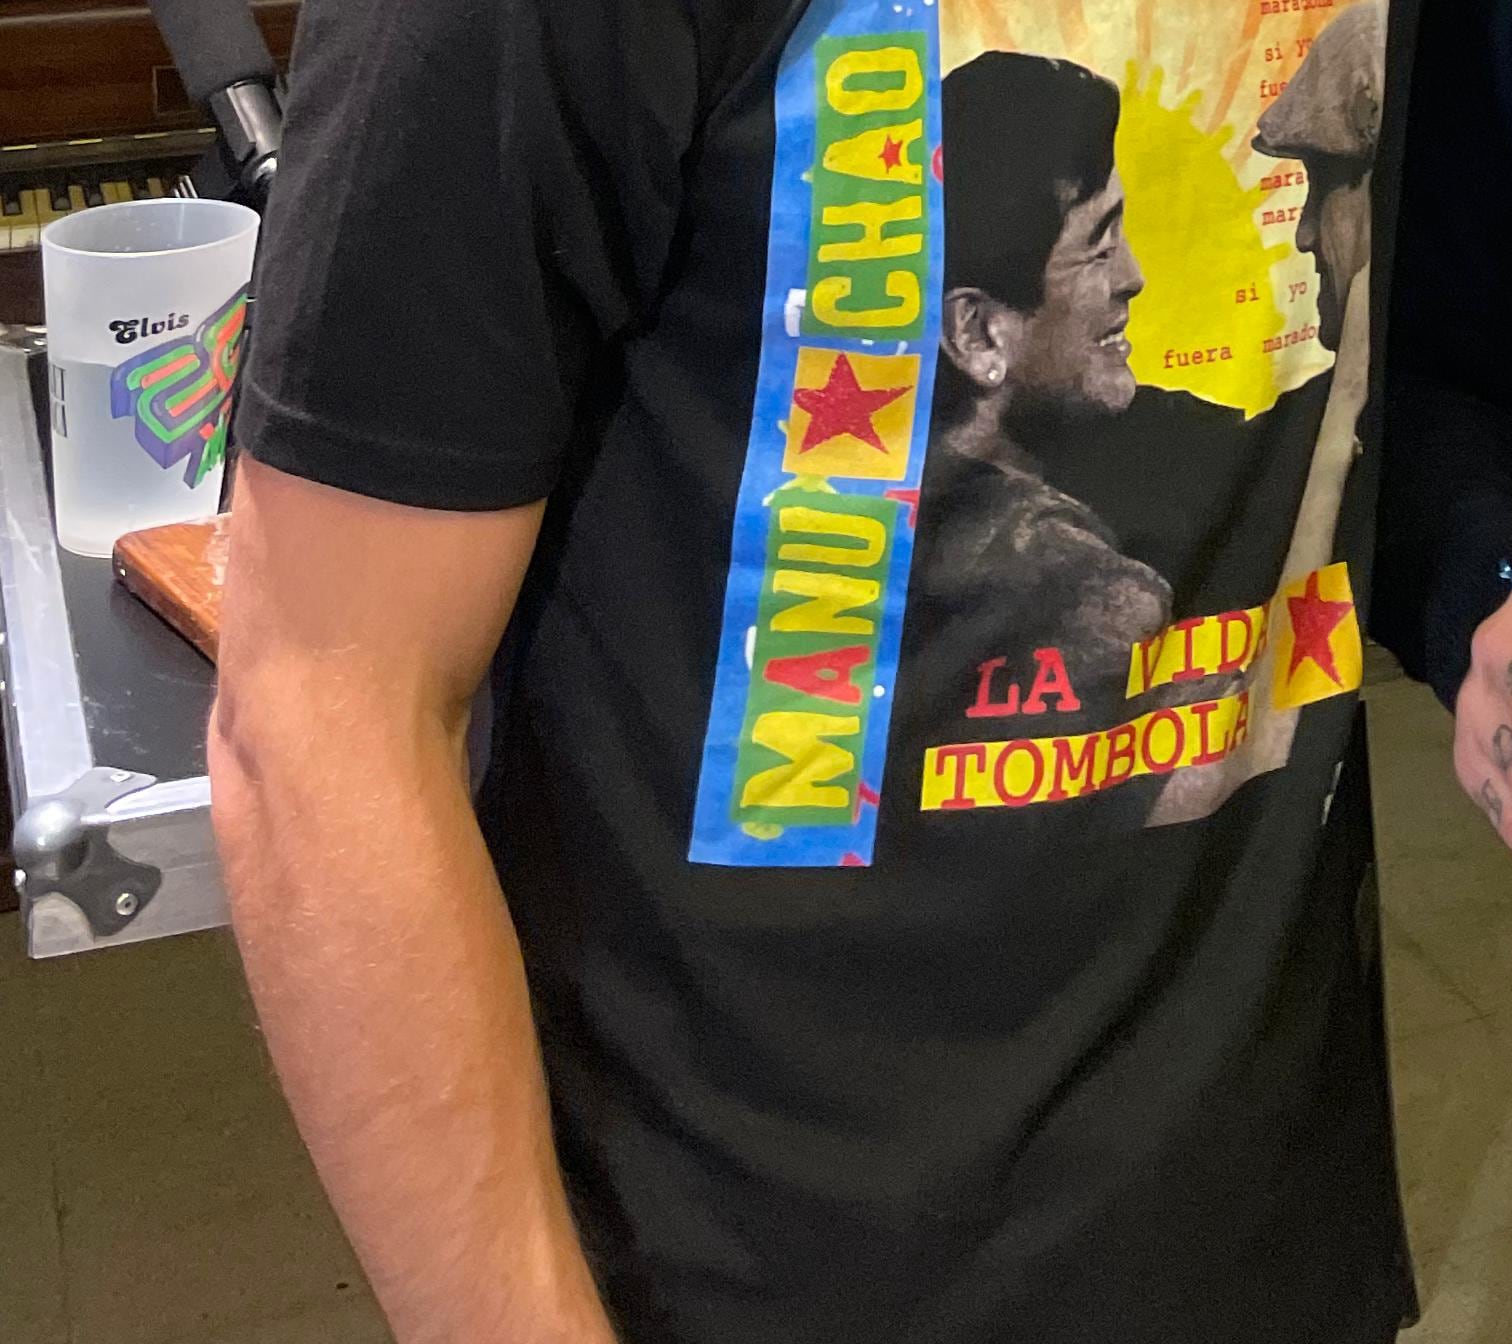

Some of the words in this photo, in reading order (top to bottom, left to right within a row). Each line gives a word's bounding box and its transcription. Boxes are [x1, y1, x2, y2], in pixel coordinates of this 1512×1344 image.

[1265, 41, 1283, 62] si
[812, 46, 923, 328] CHAO
[1235, 283, 1260, 304] si
[1288, 281, 1308, 303] yo
[109, 312, 189, 344] Elvis
[1163, 346, 1233, 369] fuera
[740, 505, 886, 808] MANU
[966, 647, 1081, 718] LA
